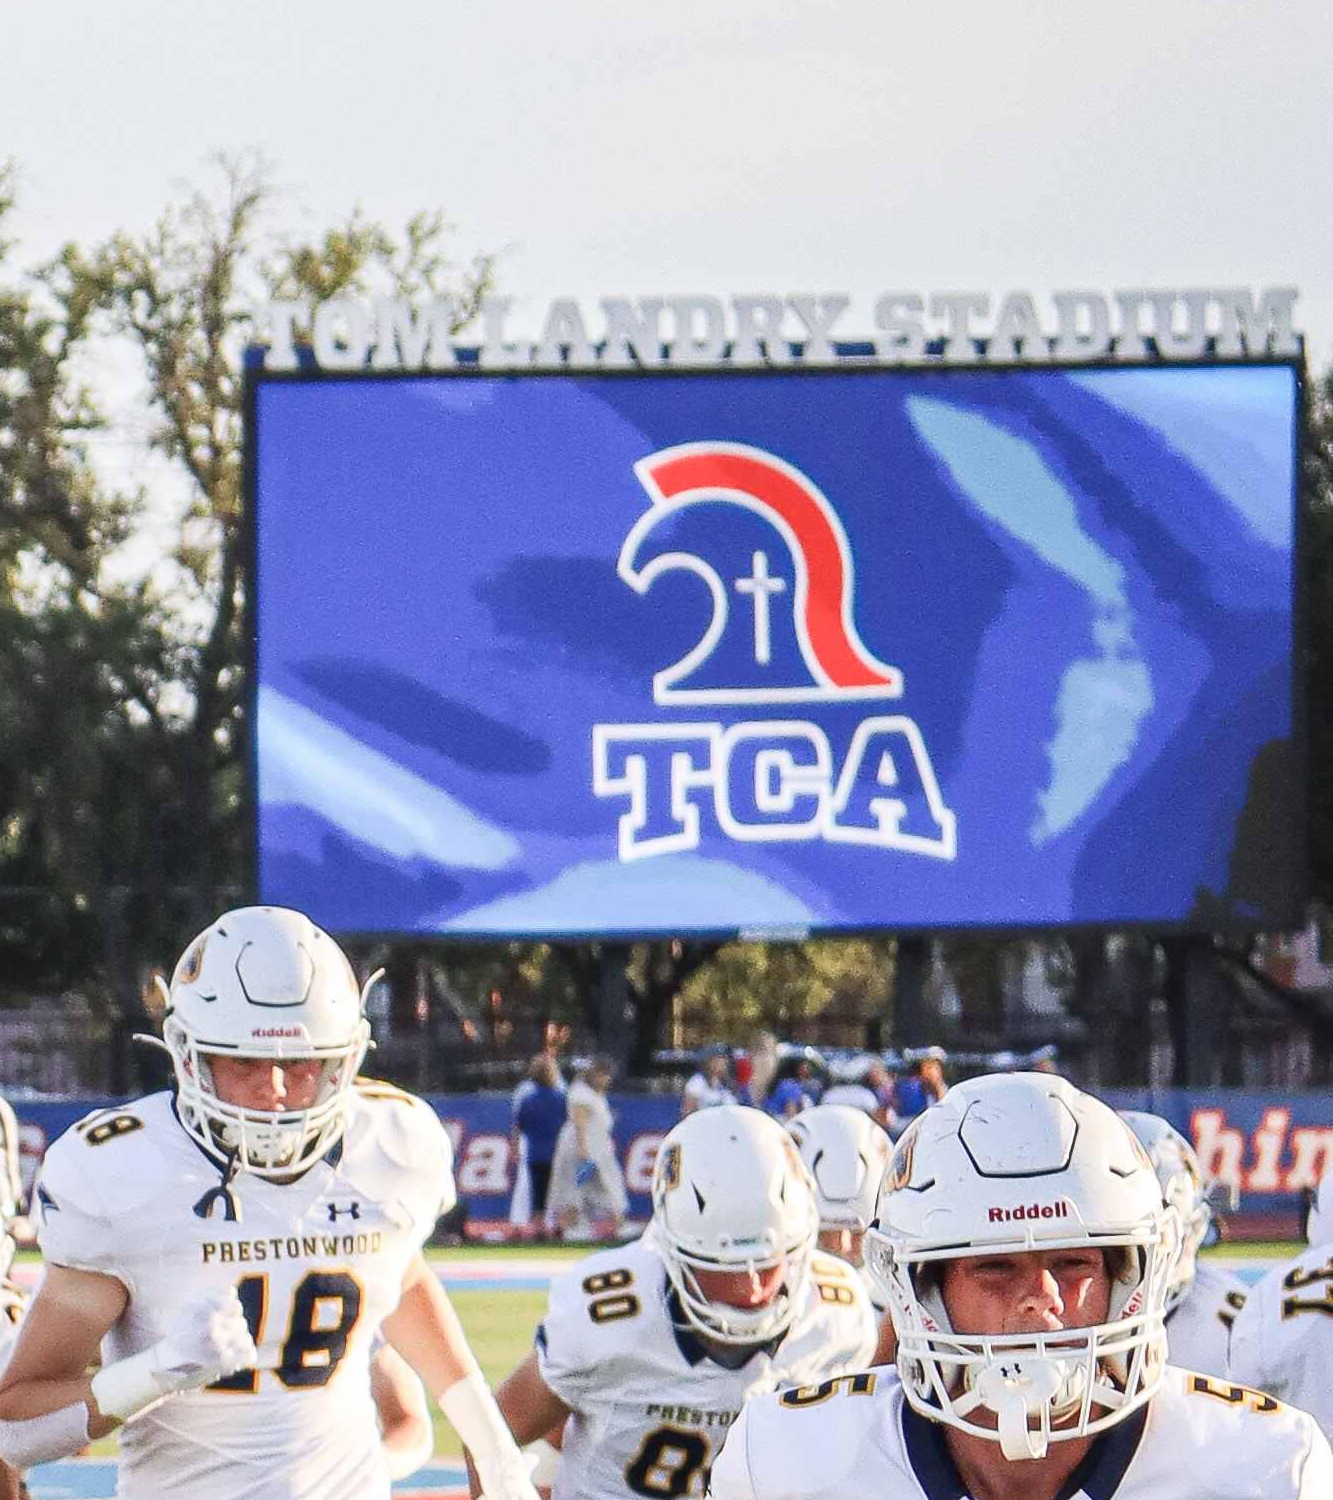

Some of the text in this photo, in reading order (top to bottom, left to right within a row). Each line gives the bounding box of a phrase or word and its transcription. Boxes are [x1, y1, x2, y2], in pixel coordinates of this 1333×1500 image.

[256, 288, 1299, 369] TOM LANDRY STADIUM
[593, 714, 957, 862] TCA
[988, 1201, 1068, 1222] Riddell
[202, 1231, 382, 1263] PRESTONWOOD
[581, 1268, 642, 1324] 80
[202, 1268, 365, 1394] 18
[647, 1403, 738, 1426] PRESTO
[624, 1422, 712, 1500] 8
